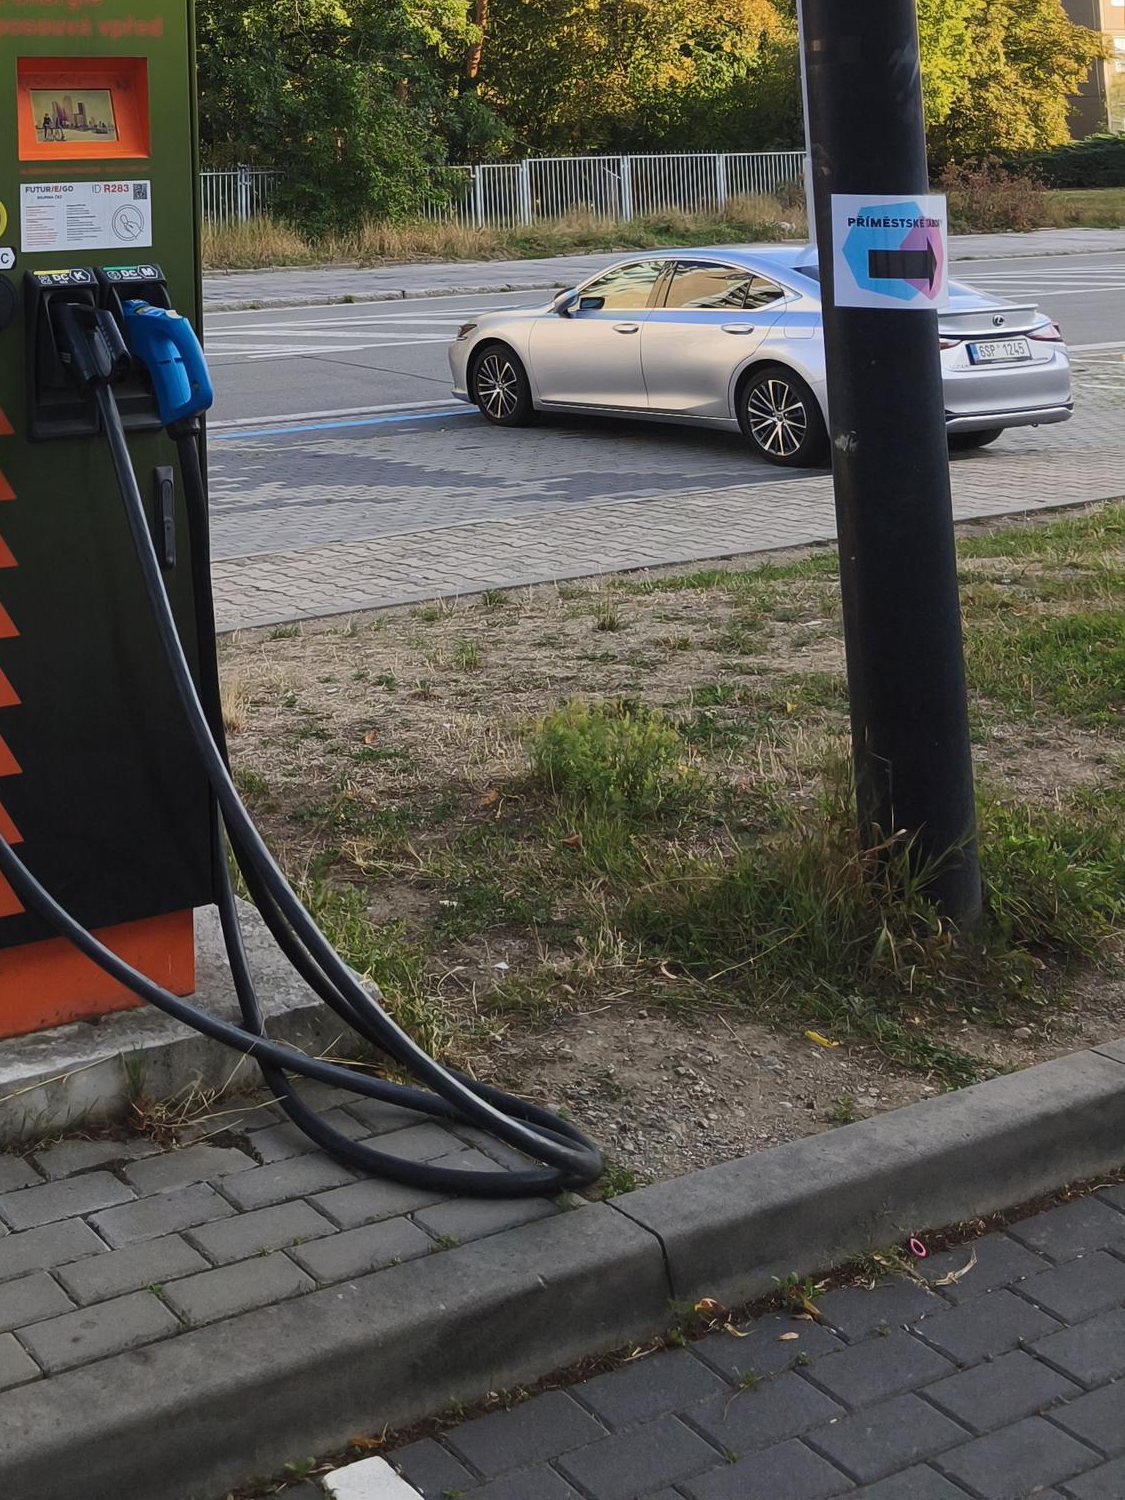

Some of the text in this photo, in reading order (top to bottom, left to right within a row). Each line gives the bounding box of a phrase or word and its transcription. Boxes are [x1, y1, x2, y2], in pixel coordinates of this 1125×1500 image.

[91, 184, 130, 193] ID R283
[847, 215, 925, 229] PŘÍMĚSTSKÉ
[0, 252, 10, 265] C
[73, 271, 87, 280] K
[120, 269, 138, 277] DC
[141, 267, 155, 277] M
[52, 273, 70, 281] DC
[978, 342, 1025, 358] 6SP 1245
